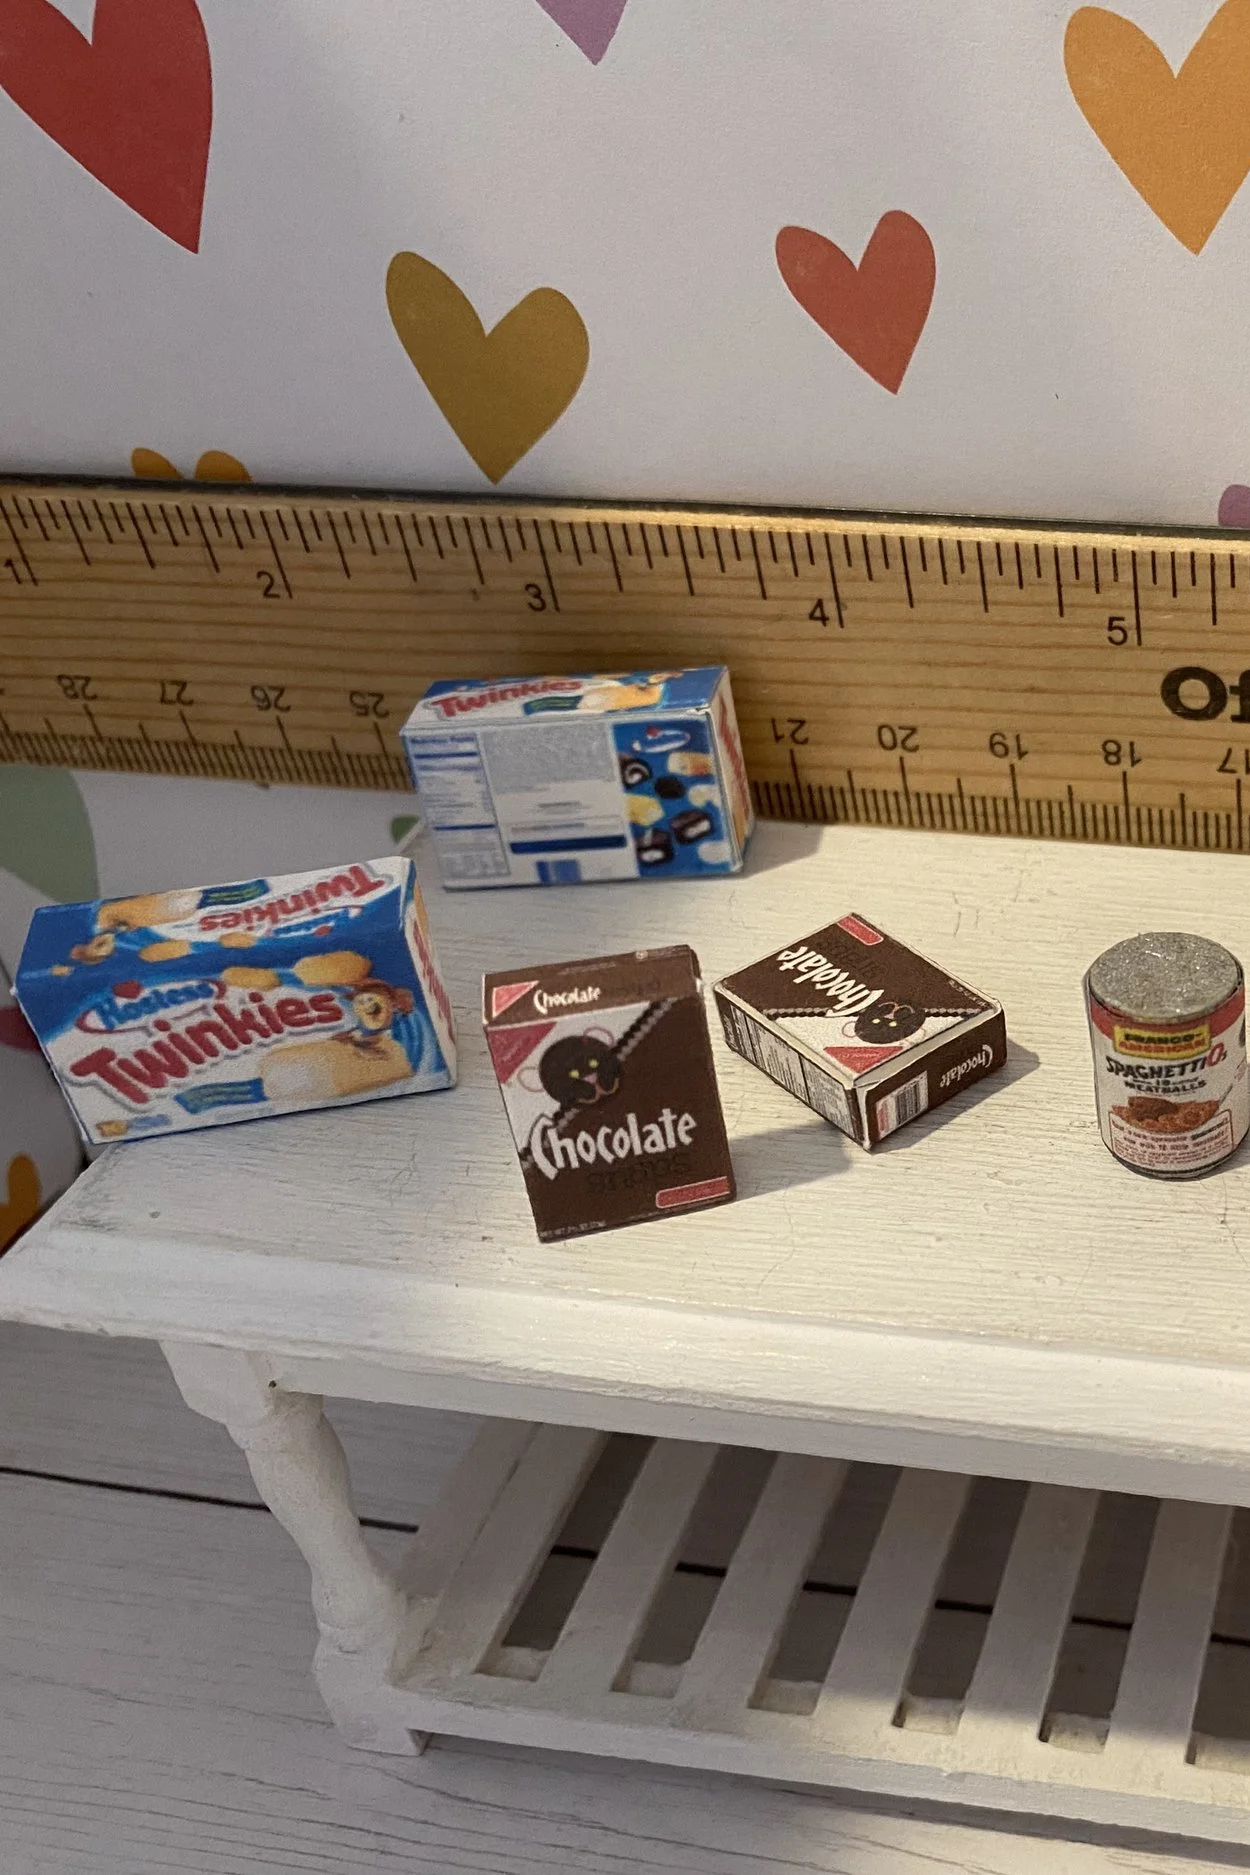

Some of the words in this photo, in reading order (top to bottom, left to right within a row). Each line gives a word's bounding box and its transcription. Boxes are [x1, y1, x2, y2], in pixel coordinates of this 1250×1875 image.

[4, 559, 21, 584] 1
[256, 571, 278, 598] 2
[524, 583, 546, 612] 3
[808, 598, 829, 627] 4
[1107, 616, 1128, 646] 5
[57, 673, 98, 700] 28
[160, 679, 195, 706] 27
[250, 684, 292, 714] 26
[432, 680, 583, 718] Twinkies
[349, 690, 390, 720] 25
[771, 717, 810, 746] 21
[877, 723, 921, 754] 20
[988, 732, 1030, 762] 19
[1101, 739, 1143, 768] 18
[199, 865, 386, 932] Twinkies
[775, 945, 885, 1018] Chocolate
[533, 985, 601, 1015] Chocolate
[69, 991, 344, 1105] Twinkies
[939, 1043, 994, 1089] Chocolate
[530, 1107, 698, 1181] Chocolate
